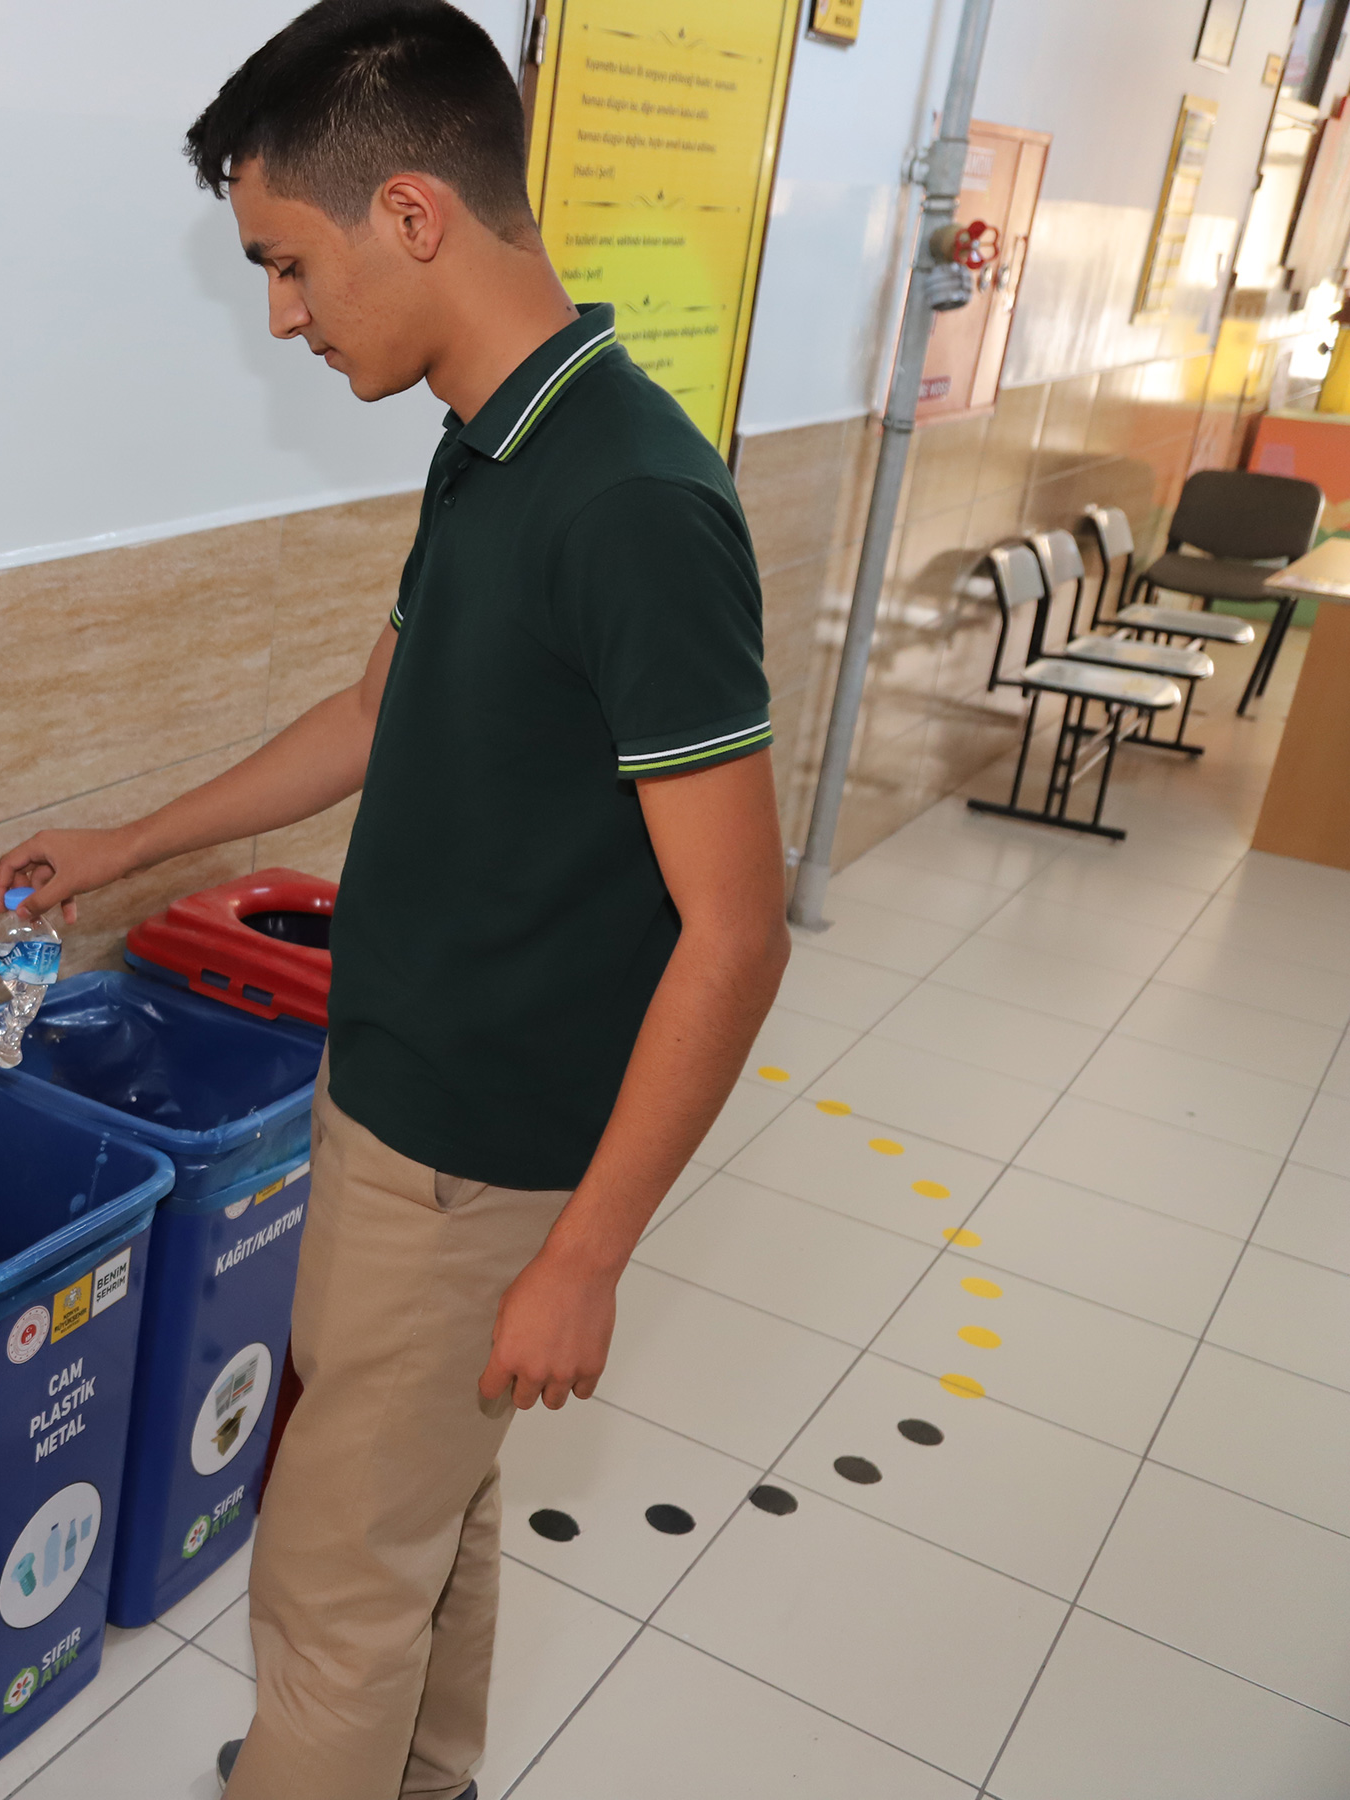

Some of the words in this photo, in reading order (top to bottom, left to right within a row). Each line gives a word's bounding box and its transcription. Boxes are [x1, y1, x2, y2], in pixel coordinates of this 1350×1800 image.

[215, 1203, 305, 1276] KAĞIT/KARTON
[97, 1262, 127, 1290] BENİM
[49, 1357, 83, 1396] CAM
[30, 1376, 96, 1439] PLASTİK
[35, 1414, 86, 1463] METAL
[210, 1503, 241, 1538] ATIK
[213, 1485, 245, 1521] SIFIR
[41, 1643, 79, 1688] ATIK
[42, 1627, 81, 1671] SIFIR
